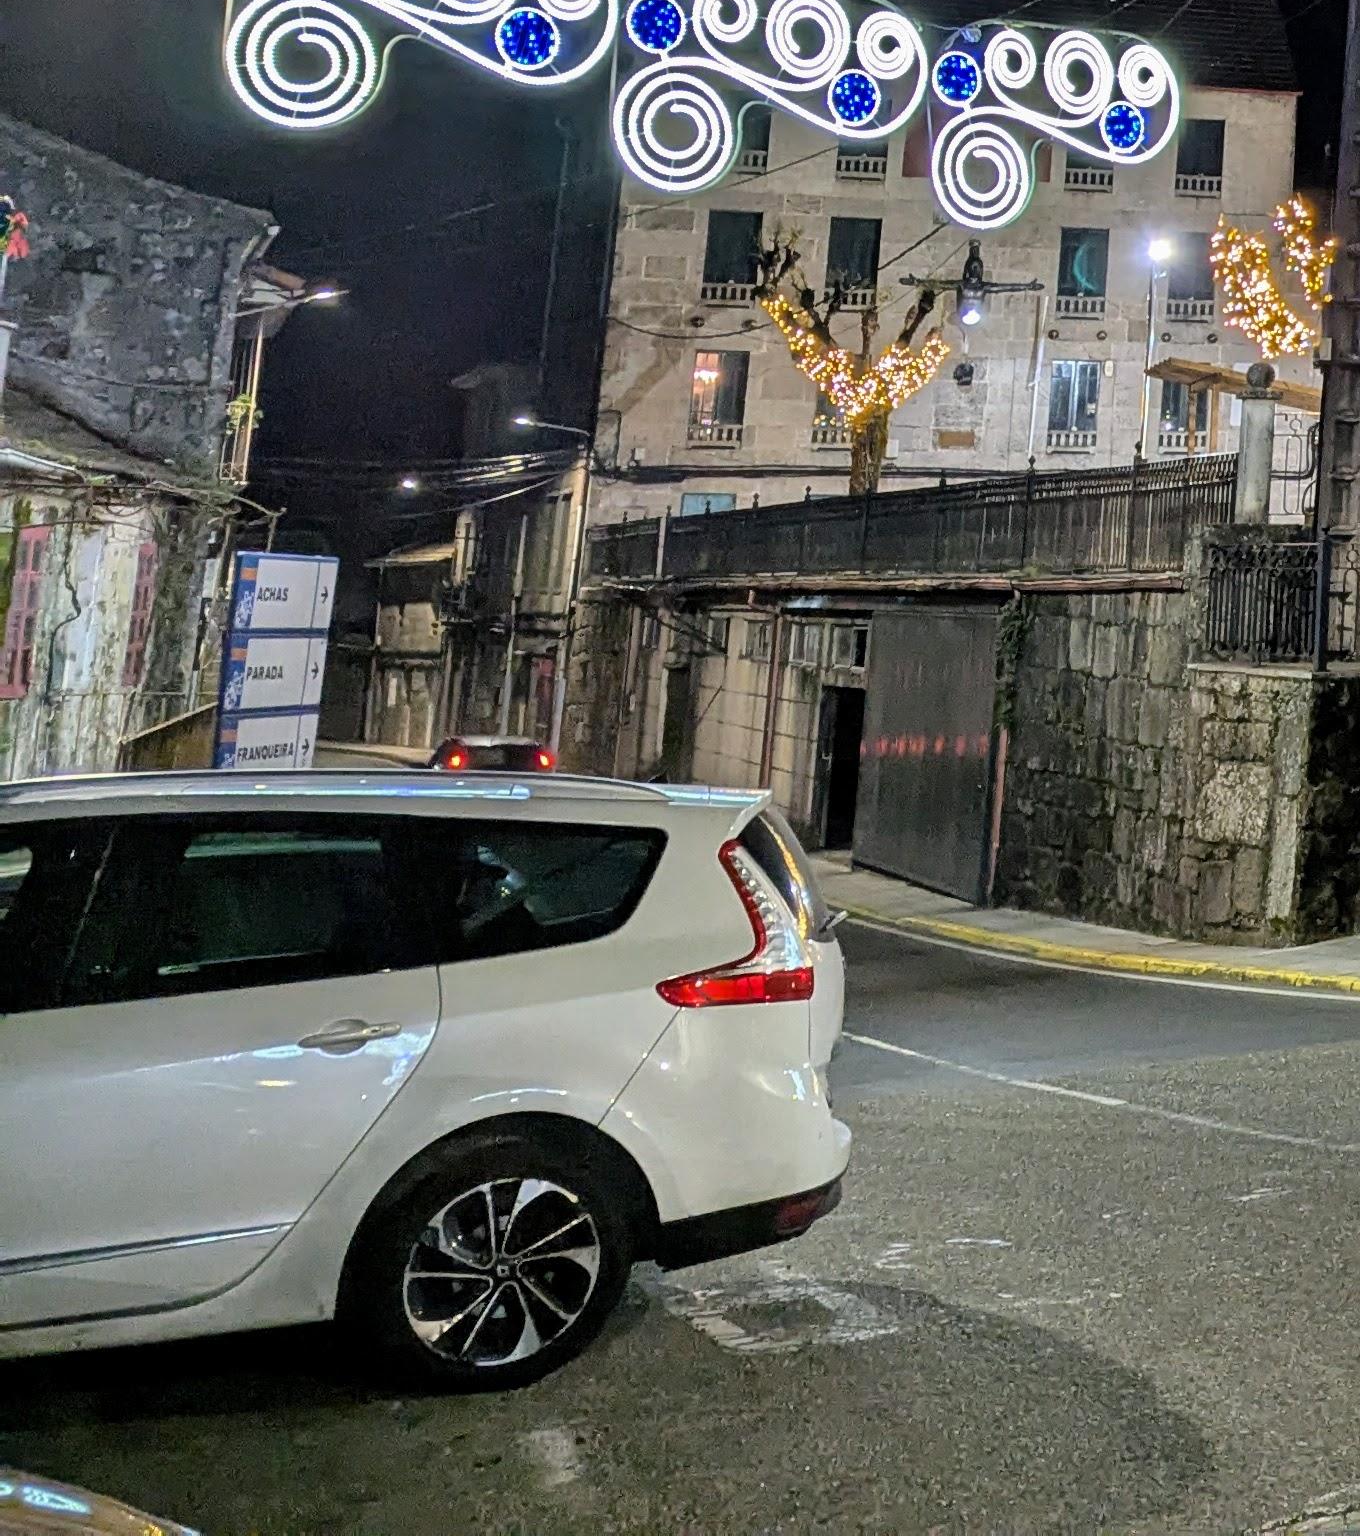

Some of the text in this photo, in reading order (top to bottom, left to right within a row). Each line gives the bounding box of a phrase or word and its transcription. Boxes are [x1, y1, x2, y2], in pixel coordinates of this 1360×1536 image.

[256, 586, 289, 602] ACHAS
[246, 665, 283, 680] PARADA
[236, 742, 294, 763] FRANQUEIRA
